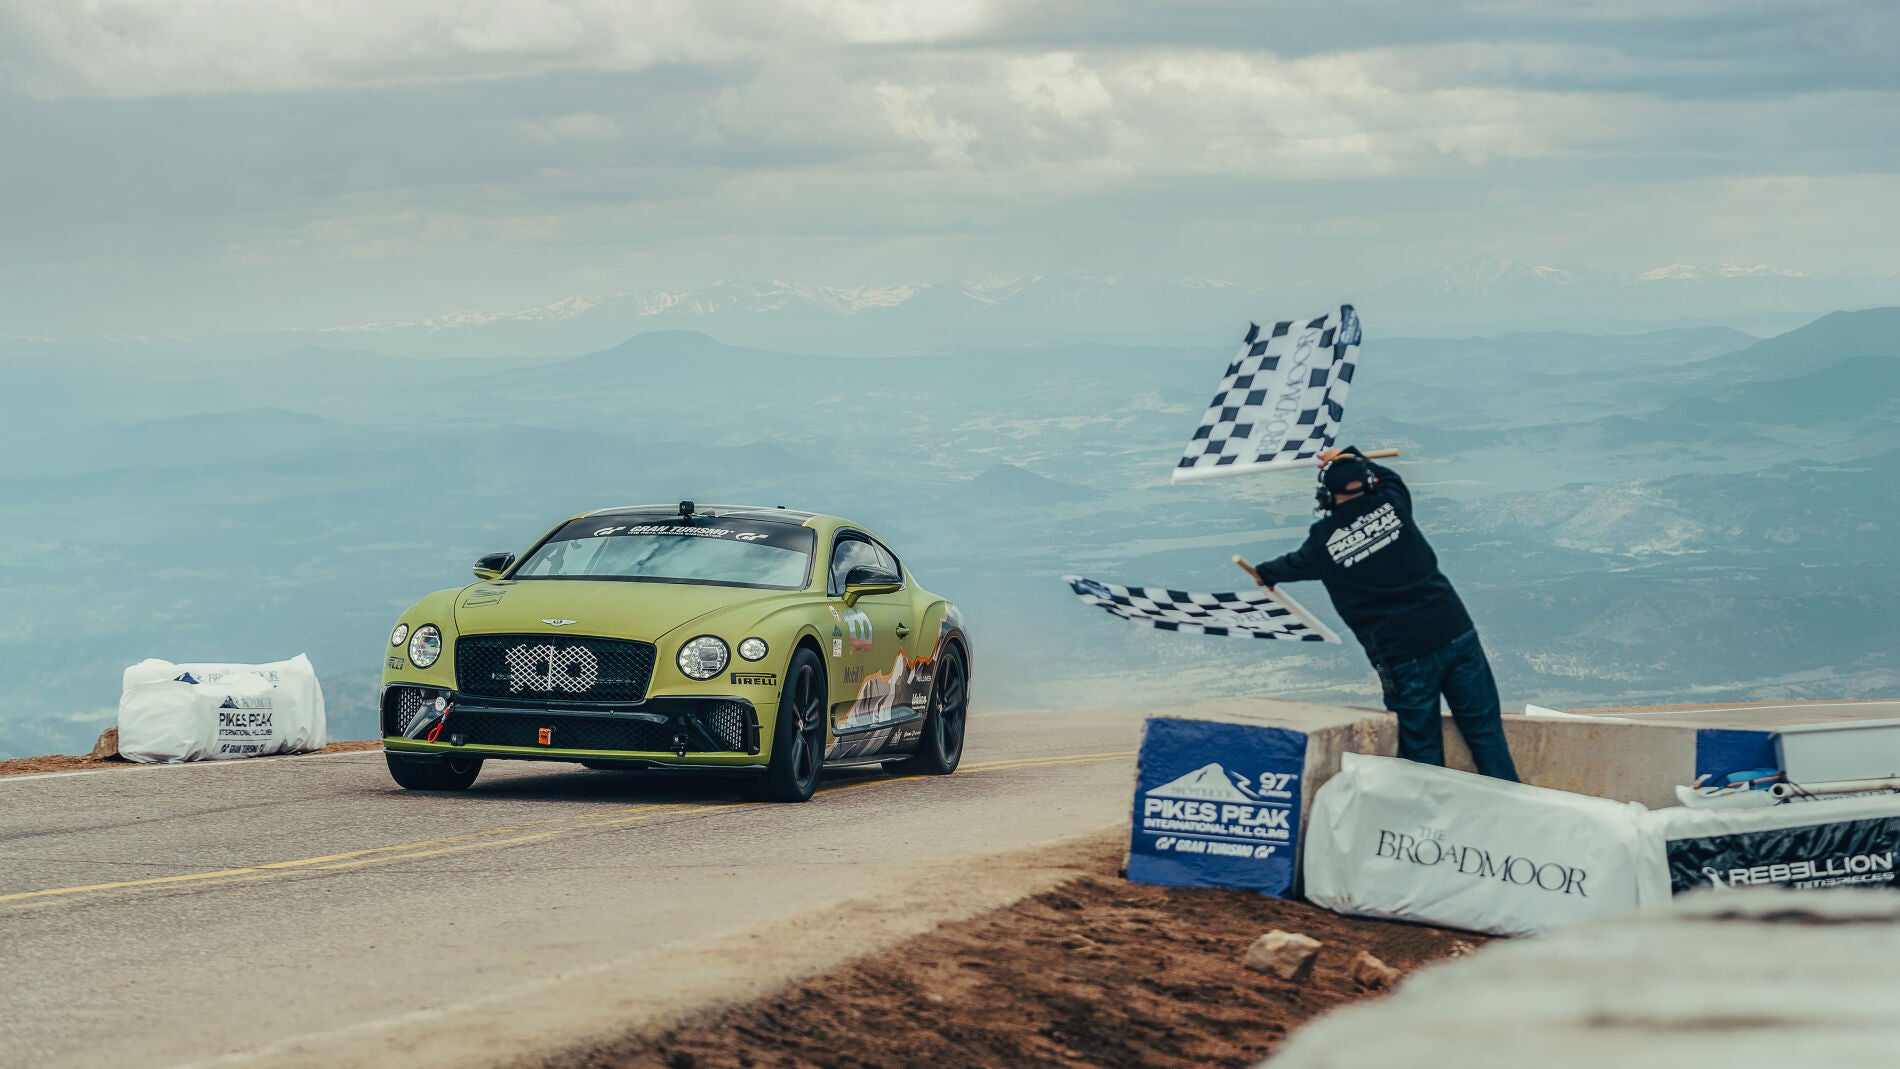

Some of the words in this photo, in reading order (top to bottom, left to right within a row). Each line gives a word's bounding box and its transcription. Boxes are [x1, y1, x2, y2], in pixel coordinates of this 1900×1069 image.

[1256, 331, 1316, 452] BROADMOOR
[669, 526, 730, 536] TURISMO
[1327, 530, 1366, 557] PIKES
[1363, 510, 1399, 538] PEAK
[505, 643, 598, 693] 100
[731, 672, 777, 686] PIRELLI
[219, 713, 247, 727] PIKES
[248, 713, 272, 727] PEAK
[1144, 798, 1217, 822] PIKES
[1221, 804, 1290, 829] PEAK
[1144, 818, 1228, 834] INTERNATIONAL
[1229, 825, 1253, 836] HILL
[1254, 827, 1290, 839] CLIMB
[1419, 825, 1448, 841] THE
[1175, 839, 1206, 853] GRAN
[1206, 842, 1254, 857] TURISMO
[1375, 829, 1589, 898] BROADMOOR
[1728, 852, 1893, 887] REBELLION
